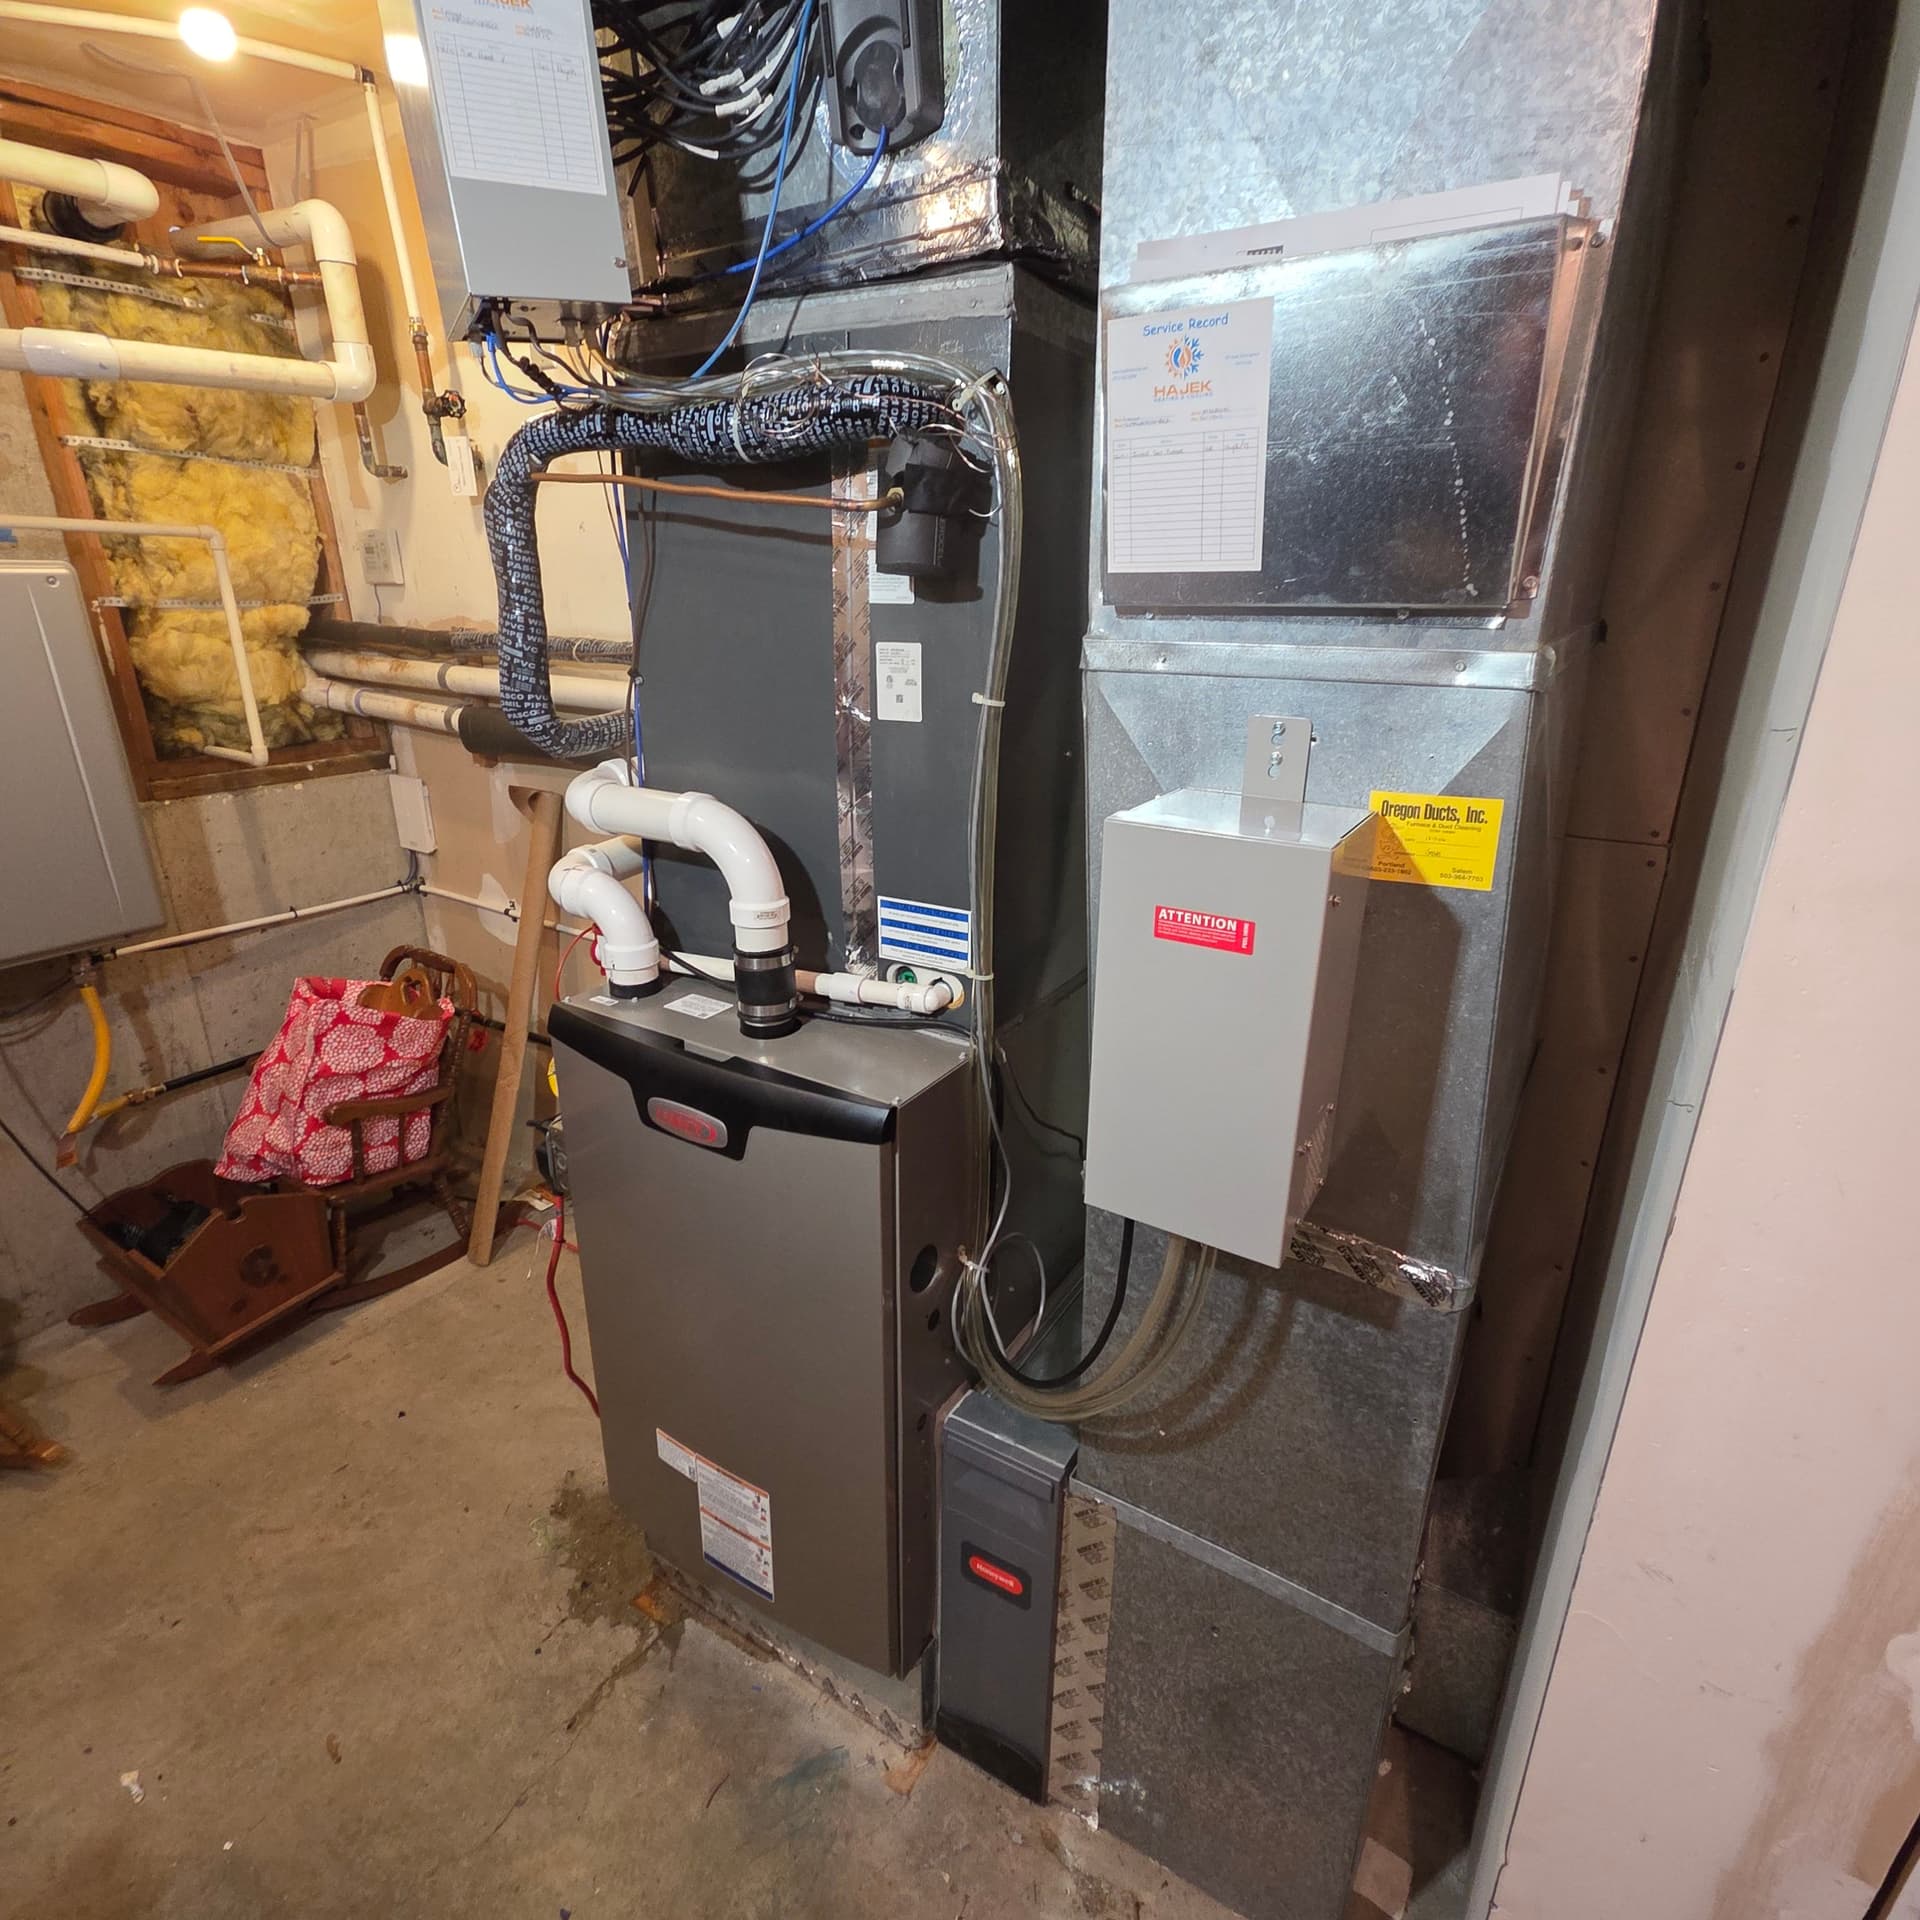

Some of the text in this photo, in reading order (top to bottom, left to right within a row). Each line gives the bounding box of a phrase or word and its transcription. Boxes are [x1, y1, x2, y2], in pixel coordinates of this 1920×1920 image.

[1143, 313, 1230, 337] Service Record
[1153, 380, 1212, 398] HAJEK
[494, 532, 526, 547] WRAP
[513, 658, 536, 670] PVC
[511, 672, 536, 684] PIPE
[1381, 800, 1488, 824] Oregon Ducts, Inc.
[1378, 860, 1406, 868] Portland
[1158, 908, 1237, 932] ATTENTION
[976, 1563, 1015, 1588] Honeywell
